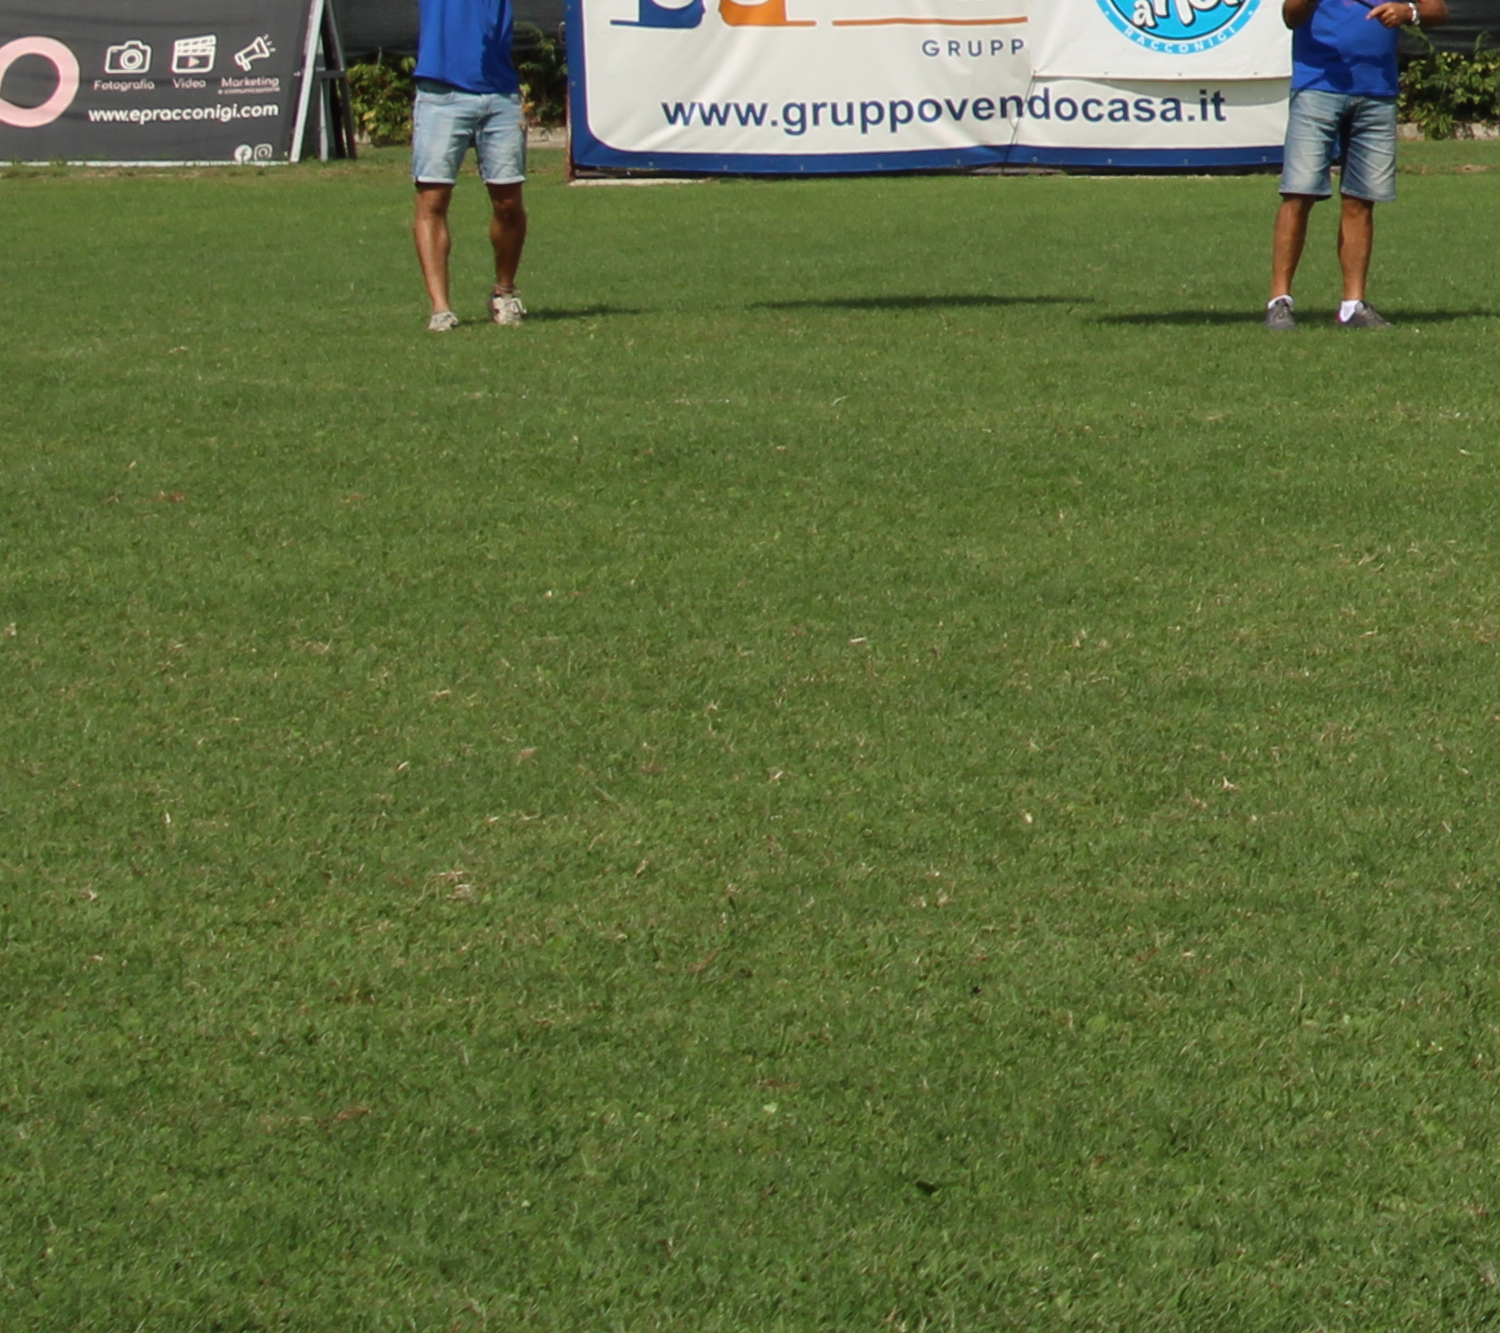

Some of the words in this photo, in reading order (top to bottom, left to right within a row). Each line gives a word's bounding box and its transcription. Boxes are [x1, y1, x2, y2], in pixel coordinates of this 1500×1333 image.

[1123, 26, 1236, 54] RACCONIGI
[94, 78, 155, 92] Fotografia
[173, 77, 206, 89] Video
[221, 76, 280, 89] Marketing
[88, 103, 279, 126] www.epracconigi.com
[660, 87, 1227, 136] www.gruppovendocasa.it
